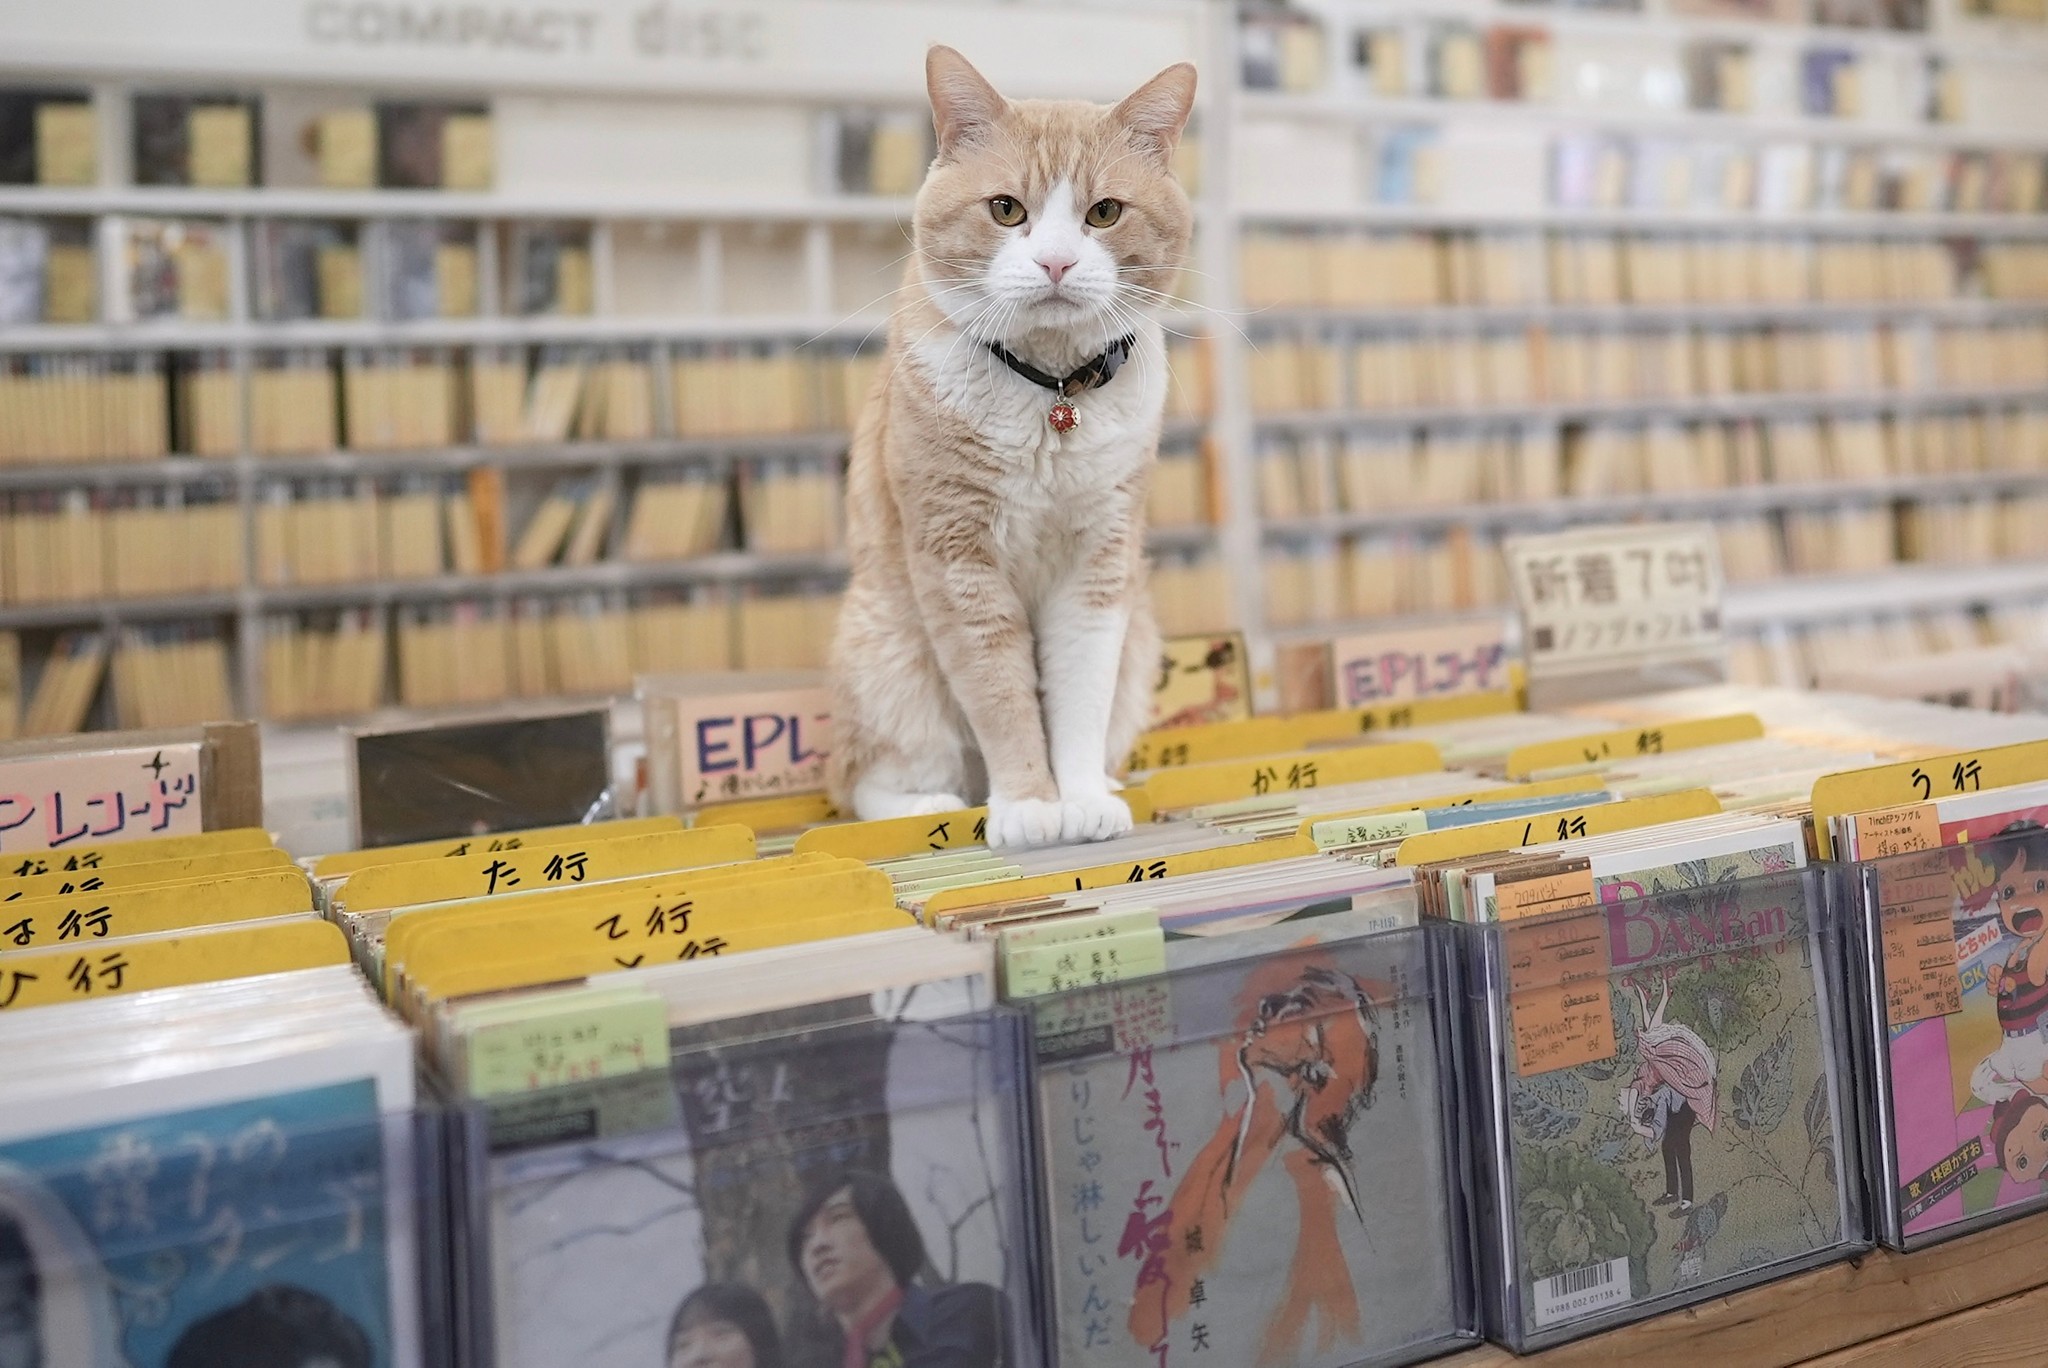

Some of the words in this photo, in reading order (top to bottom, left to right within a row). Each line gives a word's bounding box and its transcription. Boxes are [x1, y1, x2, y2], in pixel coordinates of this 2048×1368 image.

[1252, 762, 1318, 795] か行
[1911, 759, 1981, 801] う行
[482, 852, 588, 894] た行
[595, 901, 693, 939] て行
[1069, 1063, 1110, 1349] りじゃ淋しいんだ
